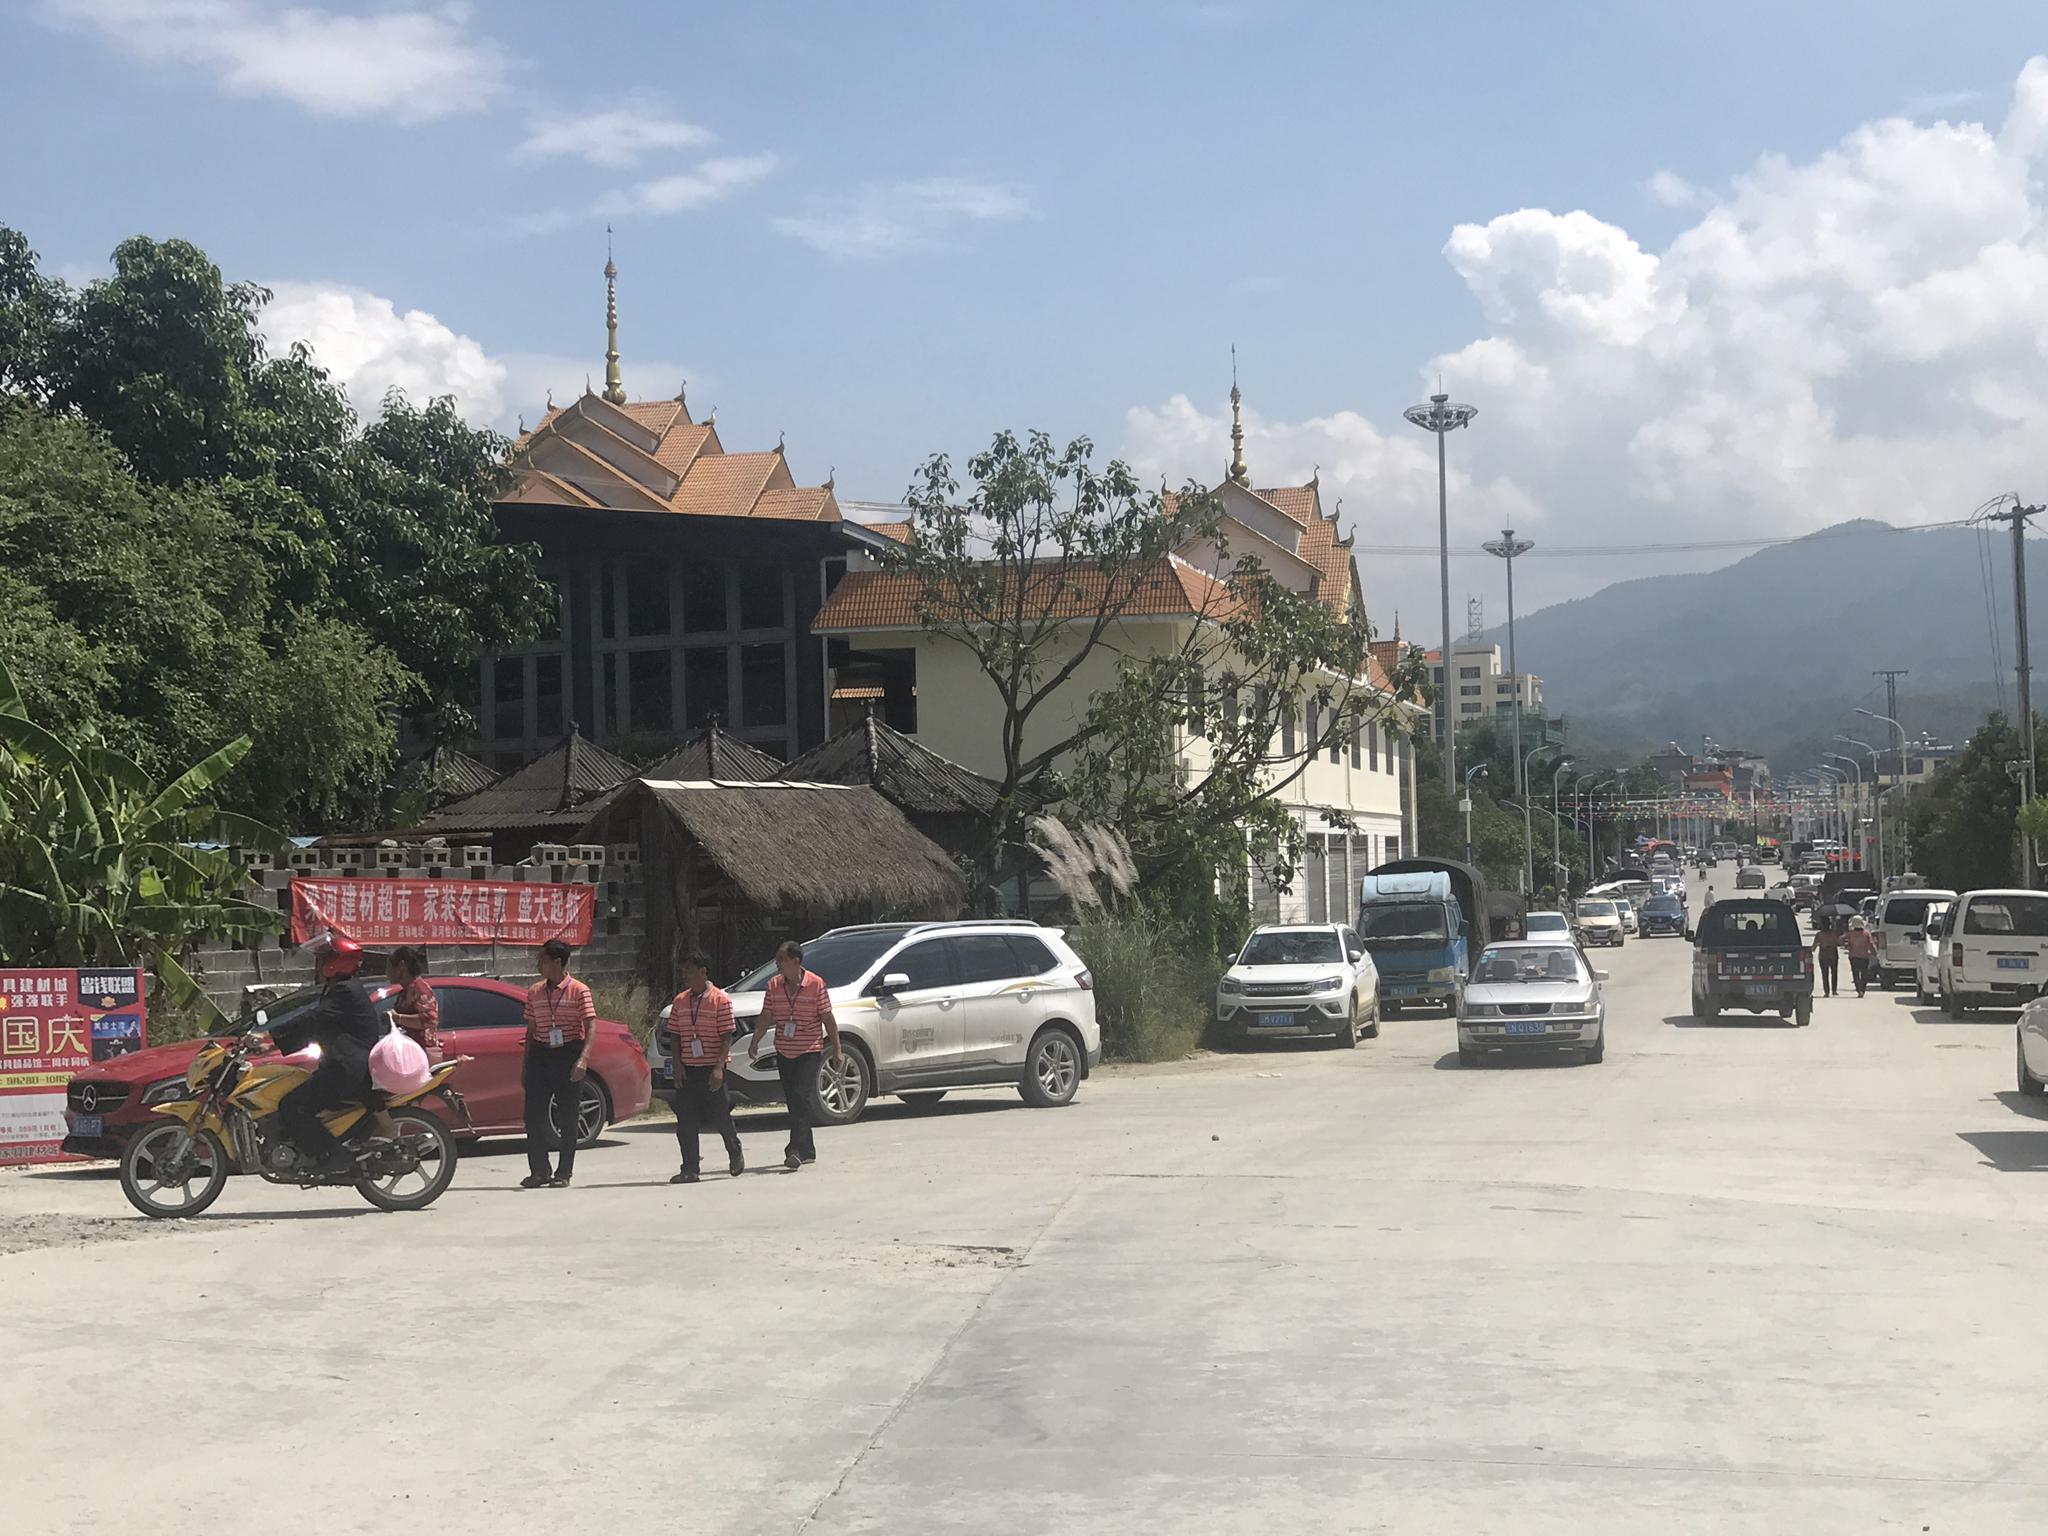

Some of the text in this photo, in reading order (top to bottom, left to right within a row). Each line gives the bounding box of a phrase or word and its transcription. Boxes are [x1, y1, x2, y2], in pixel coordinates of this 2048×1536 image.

[424, 884, 508, 923] 家装名品惠
[80, 976, 136, 995] 省钱联盟
[11, 994, 68, 1008] 强强联手
[3, 1013, 88, 1055] 国庆
